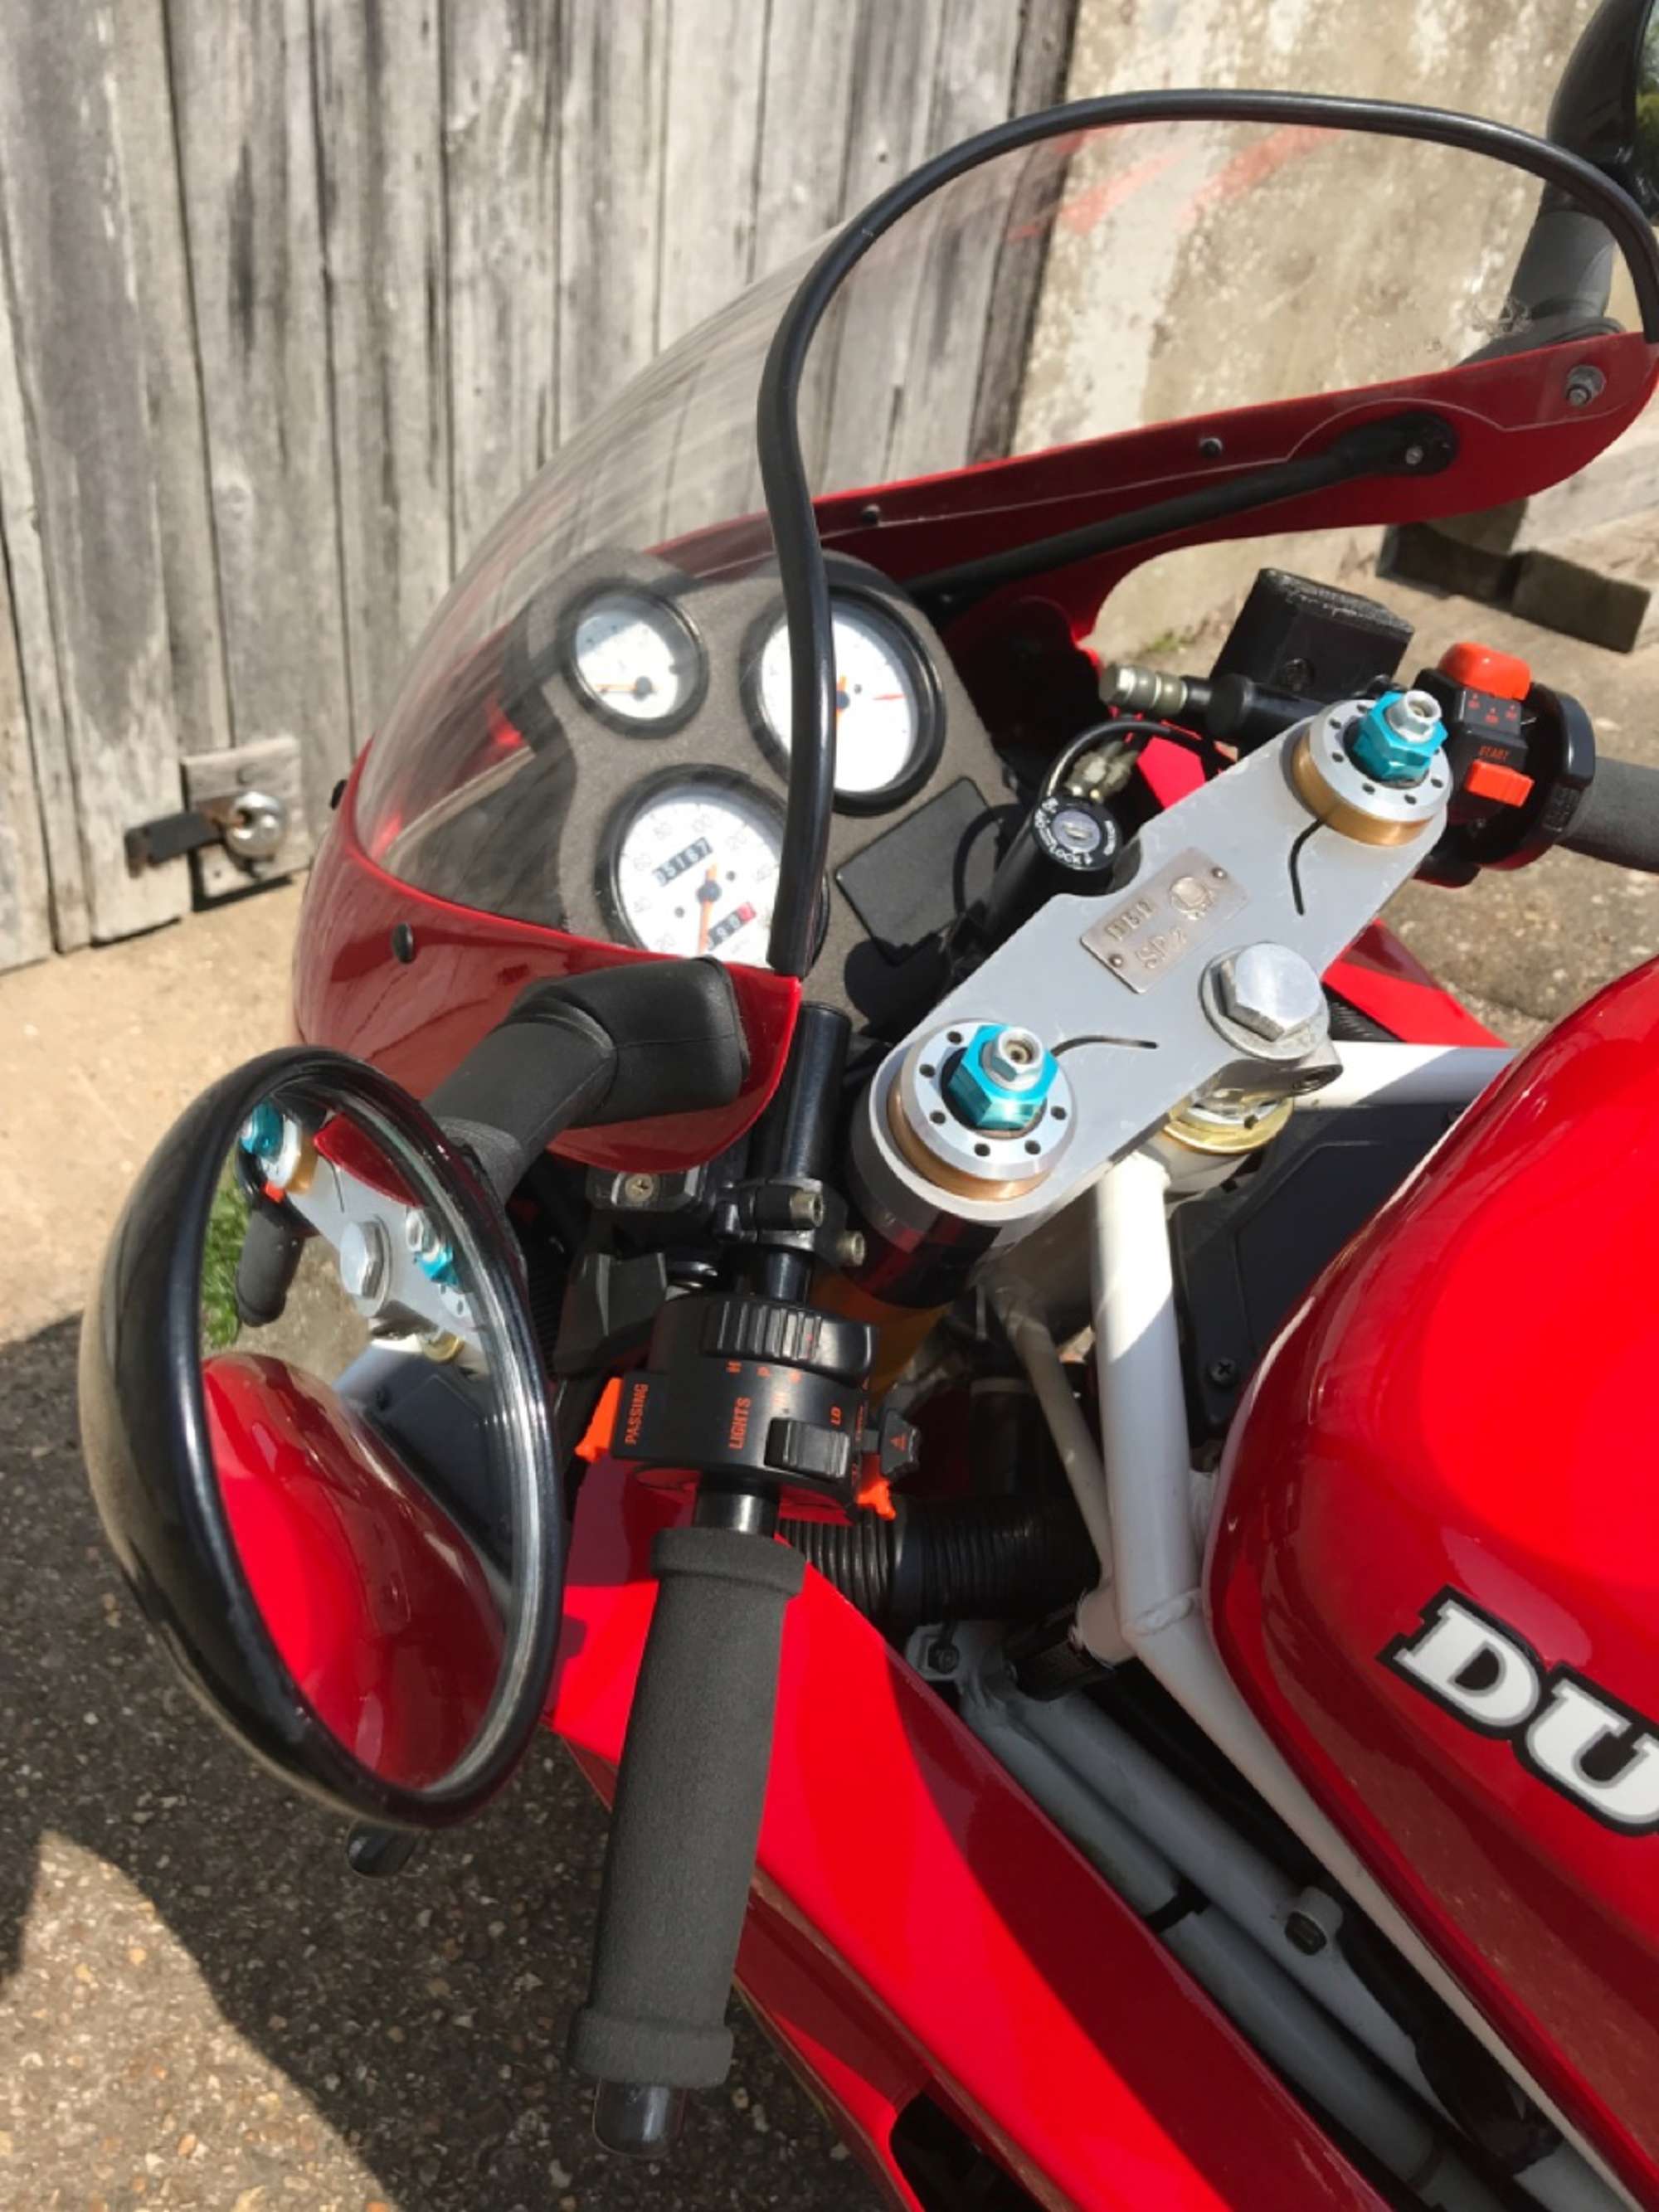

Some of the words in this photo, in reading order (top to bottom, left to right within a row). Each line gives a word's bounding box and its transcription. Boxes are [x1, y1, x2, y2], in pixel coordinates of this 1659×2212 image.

[625, 1383, 649, 1445] PASSING
[728, 1397, 752, 1449] LIGHTS
[1387, 1590, 1659, 1830] DU
